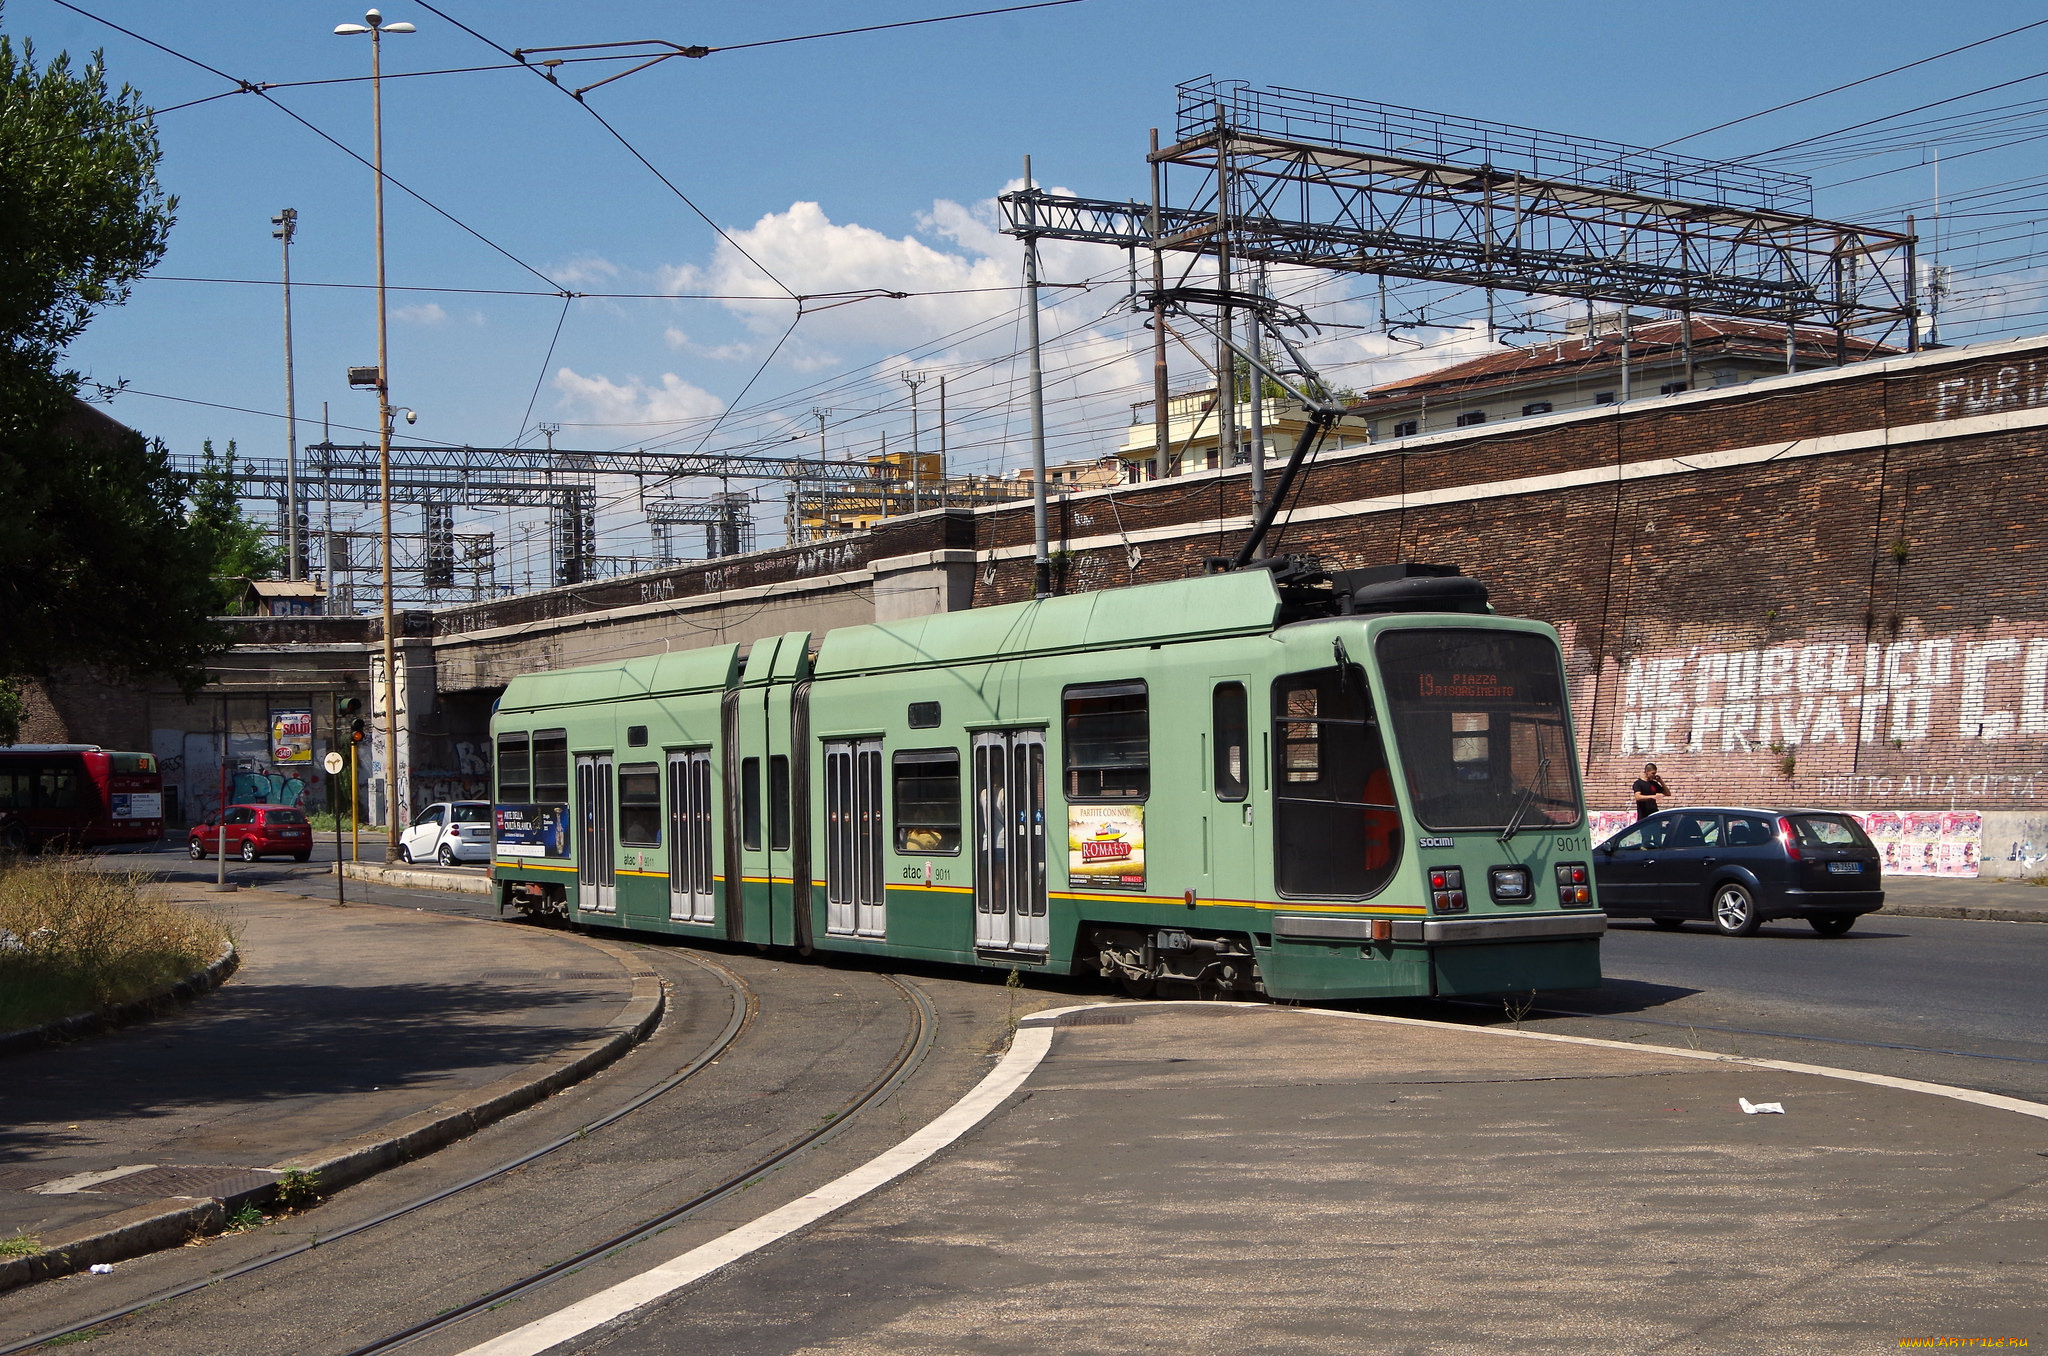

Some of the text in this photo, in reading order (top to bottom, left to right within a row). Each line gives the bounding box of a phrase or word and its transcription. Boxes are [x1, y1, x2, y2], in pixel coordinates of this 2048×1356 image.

[641, 577, 674, 603] RUNA
[1696, 638, 1952, 702] PUBBLICO
[1419, 674, 1497, 696] 19 PIAZZA
[1435, 685, 1514, 696] RISORGIMENTO
[1686, 686, 1932, 752] PRIVATO
[283, 723, 310, 735] SALDI
[1899, 775, 1957, 798] ALLA
[1080, 808, 1102, 817] PARTITE
[1103, 808, 1116, 817] CON
[1556, 837, 1588, 852] 9011
[623, 853, 636, 865] atac
[903, 864, 951, 880] atac 9011
